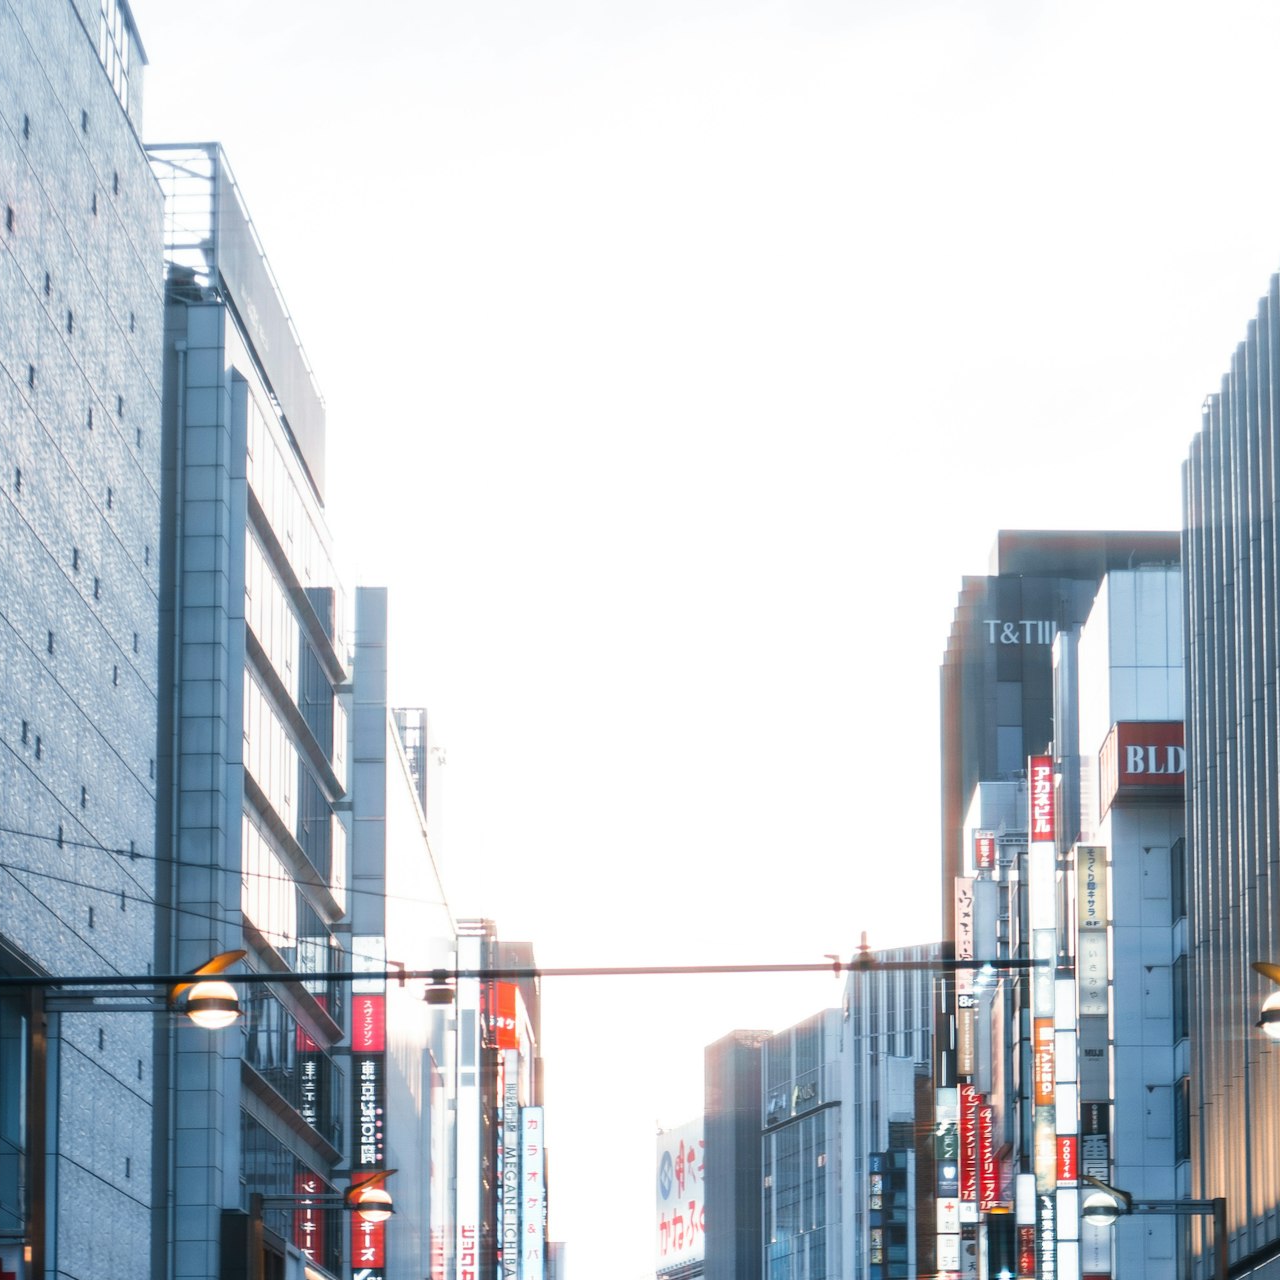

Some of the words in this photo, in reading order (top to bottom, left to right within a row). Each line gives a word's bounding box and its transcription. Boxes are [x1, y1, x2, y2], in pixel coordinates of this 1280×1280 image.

[1033, 766, 1051, 833] アカネビル
[1084, 1048, 1104, 1058] MUJI
[505, 1147, 517, 1222] MEGANE
[505, 1227, 516, 1278] ICHIBA
